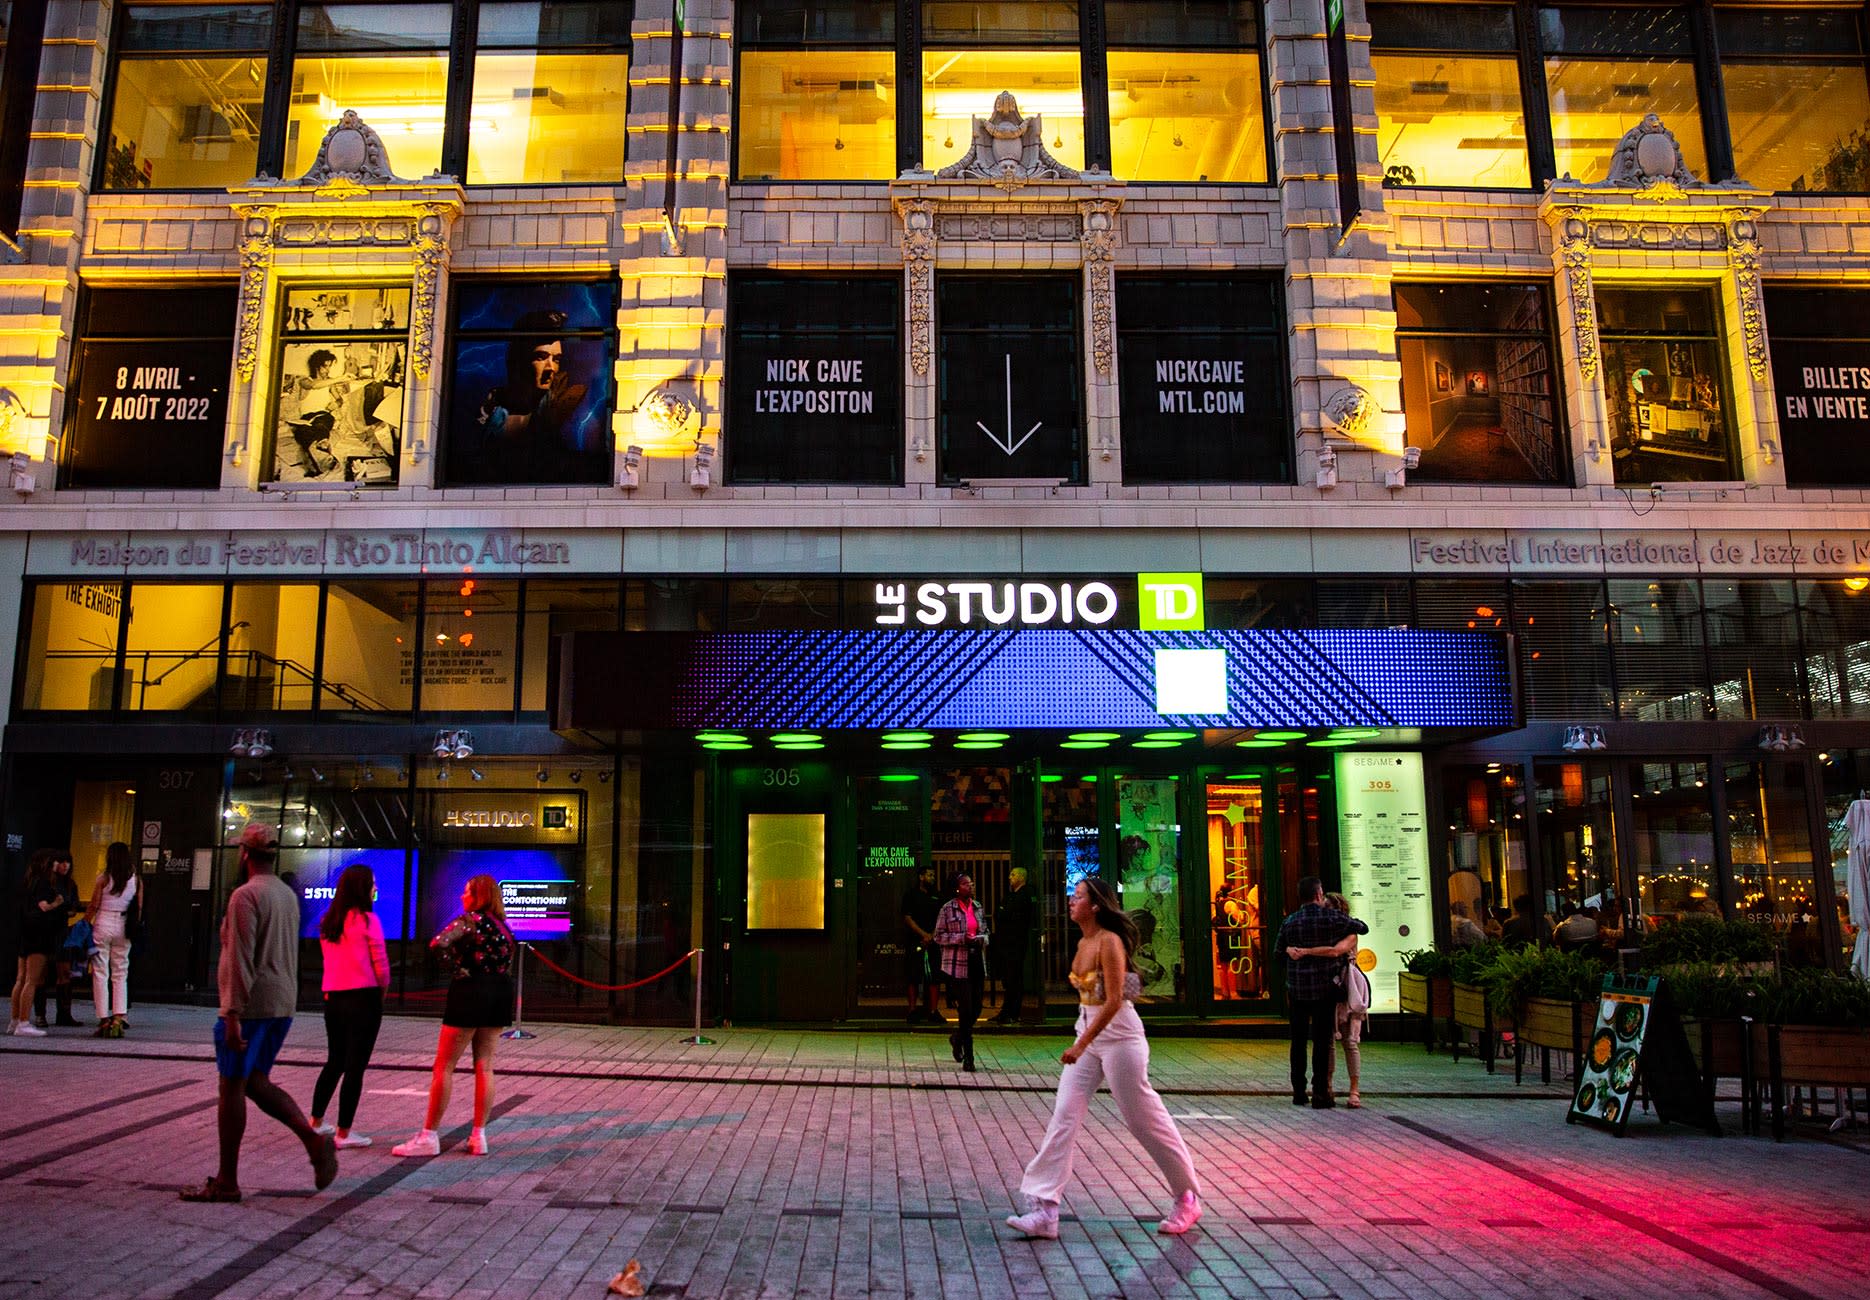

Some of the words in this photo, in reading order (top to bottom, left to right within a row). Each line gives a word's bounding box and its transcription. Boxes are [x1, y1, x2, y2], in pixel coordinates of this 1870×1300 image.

[116, 366, 128, 390] 8
[132, 367, 181, 390] AVRIL
[767, 359, 810, 382] NICK
[817, 360, 863, 382] CAVE
[1156, 359, 1245, 383] NICKCAVE
[1802, 367, 1870, 390] BILLETS
[96, 396, 108, 420] 7
[110, 393, 161, 420] AOÛT
[165, 397, 210, 420] 2022
[755, 390, 873, 413] L'EXPOSITON
[1159, 390, 1245, 414] MTL.COM
[1785, 396, 1809, 418] EN
[1812, 396, 1869, 419] VENTE
[71, 539, 168, 566] Maison
[175, 540, 211, 566] du
[220, 538, 328, 566] Festival
[476, 532, 570, 565] Alcan
[1414, 537, 1521, 564] Festival
[1528, 537, 1703, 565] International
[1710, 539, 1744, 565] de
[1750, 539, 1808, 565] Jazz
[1812, 539, 1847, 565] de
[85, 587, 135, 625] EXHIBITN
[875, 583, 905, 624] LE
[916, 582, 1118, 625] STUDIO
[1144, 583, 1198, 621] TD
[1353, 757, 1395, 767] SESAME
[160, 770, 194, 789] 307
[762, 767, 800, 787] 305
[1368, 780, 1392, 789] 305
[461, 809, 534, 827] STUDIO
[545, 808, 565, 825] TD
[164, 858, 191, 868] ZONE
[864, 856, 915, 868] L'EXPOSITION
[870, 846, 889, 857] NICK
[890, 847, 909, 857] CAVE
[502, 896, 568, 905] CONTORTIONIST
[1224, 834, 1254, 976] SESAME
[1747, 912, 1800, 924] SESAME
